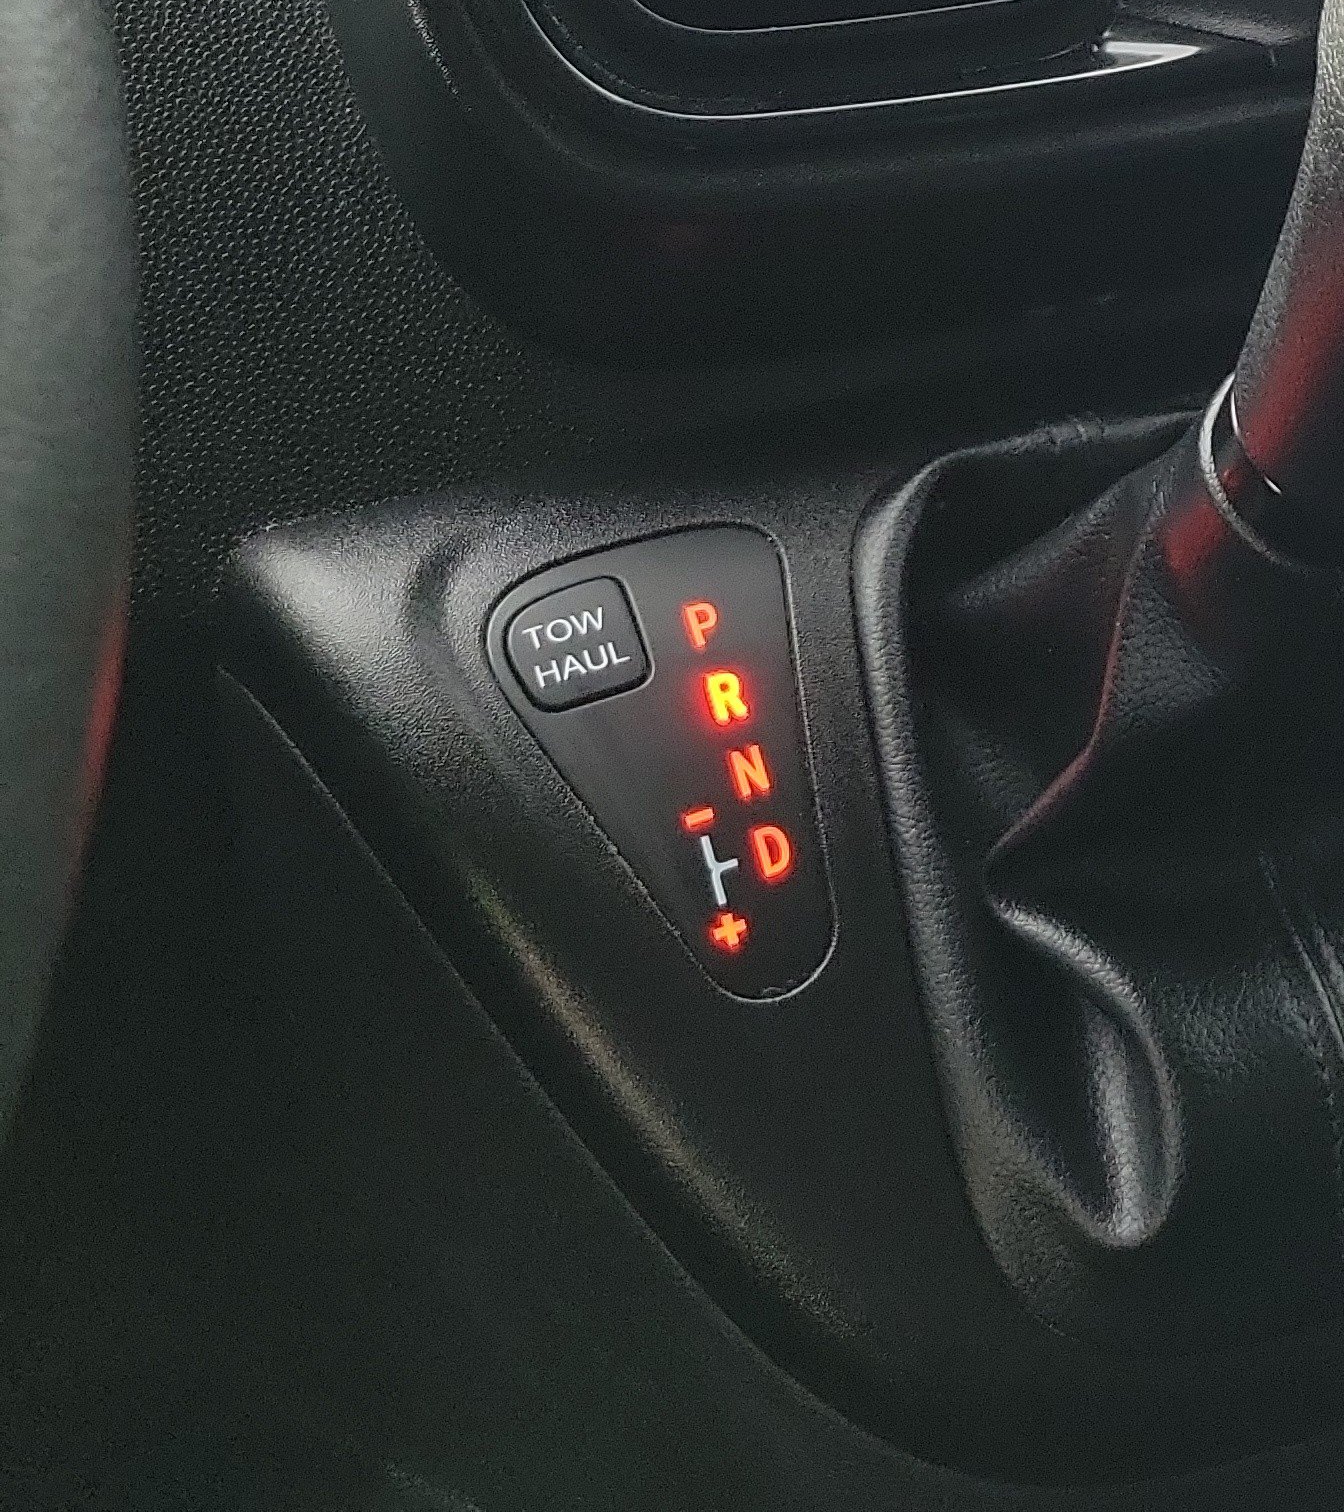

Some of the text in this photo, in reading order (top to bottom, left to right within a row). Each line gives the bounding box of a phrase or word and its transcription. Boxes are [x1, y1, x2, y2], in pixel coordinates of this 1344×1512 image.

[521, 606, 606, 652] TOW
[683, 601, 718, 649] P
[533, 641, 631, 690] HAUL
[705, 670, 749, 726] R
[729, 744, 771, 801] N
[753, 825, 792, 881] D
